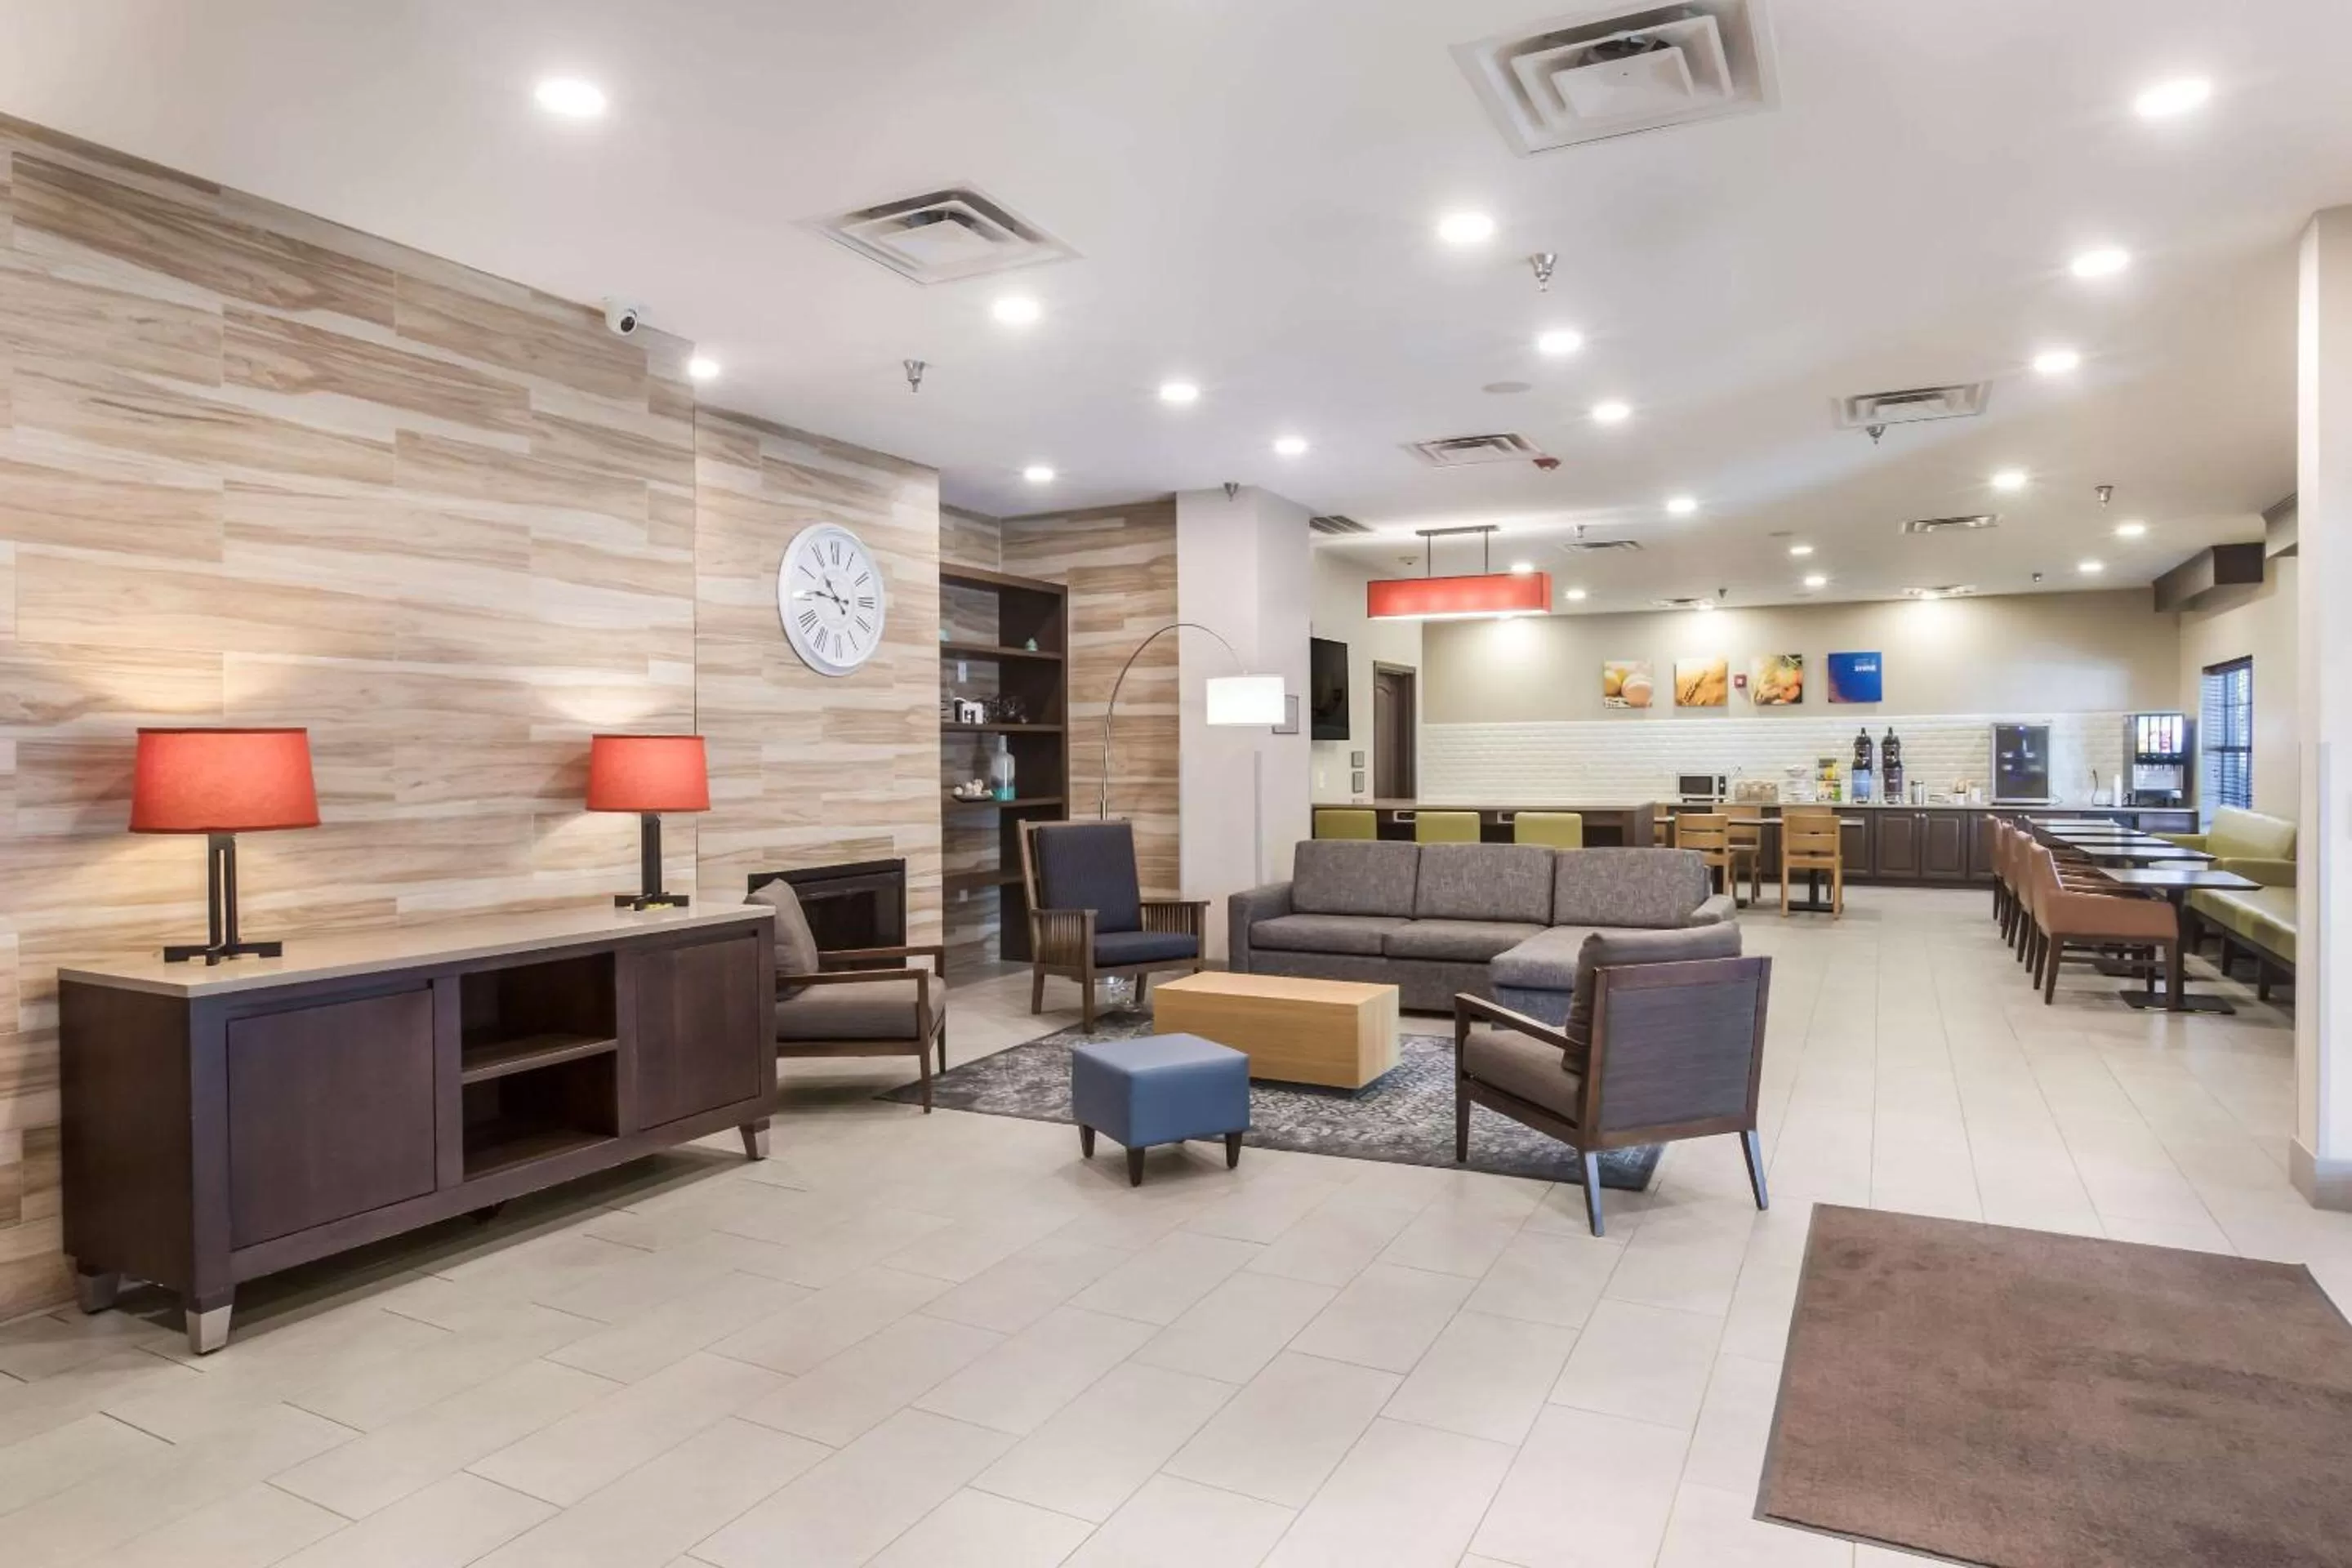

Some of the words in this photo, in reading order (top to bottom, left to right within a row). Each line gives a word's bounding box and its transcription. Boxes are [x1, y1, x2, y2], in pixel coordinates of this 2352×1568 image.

[846, 552, 855, 572] I
[855, 572, 871, 587] II
[858, 597, 875, 608] III
